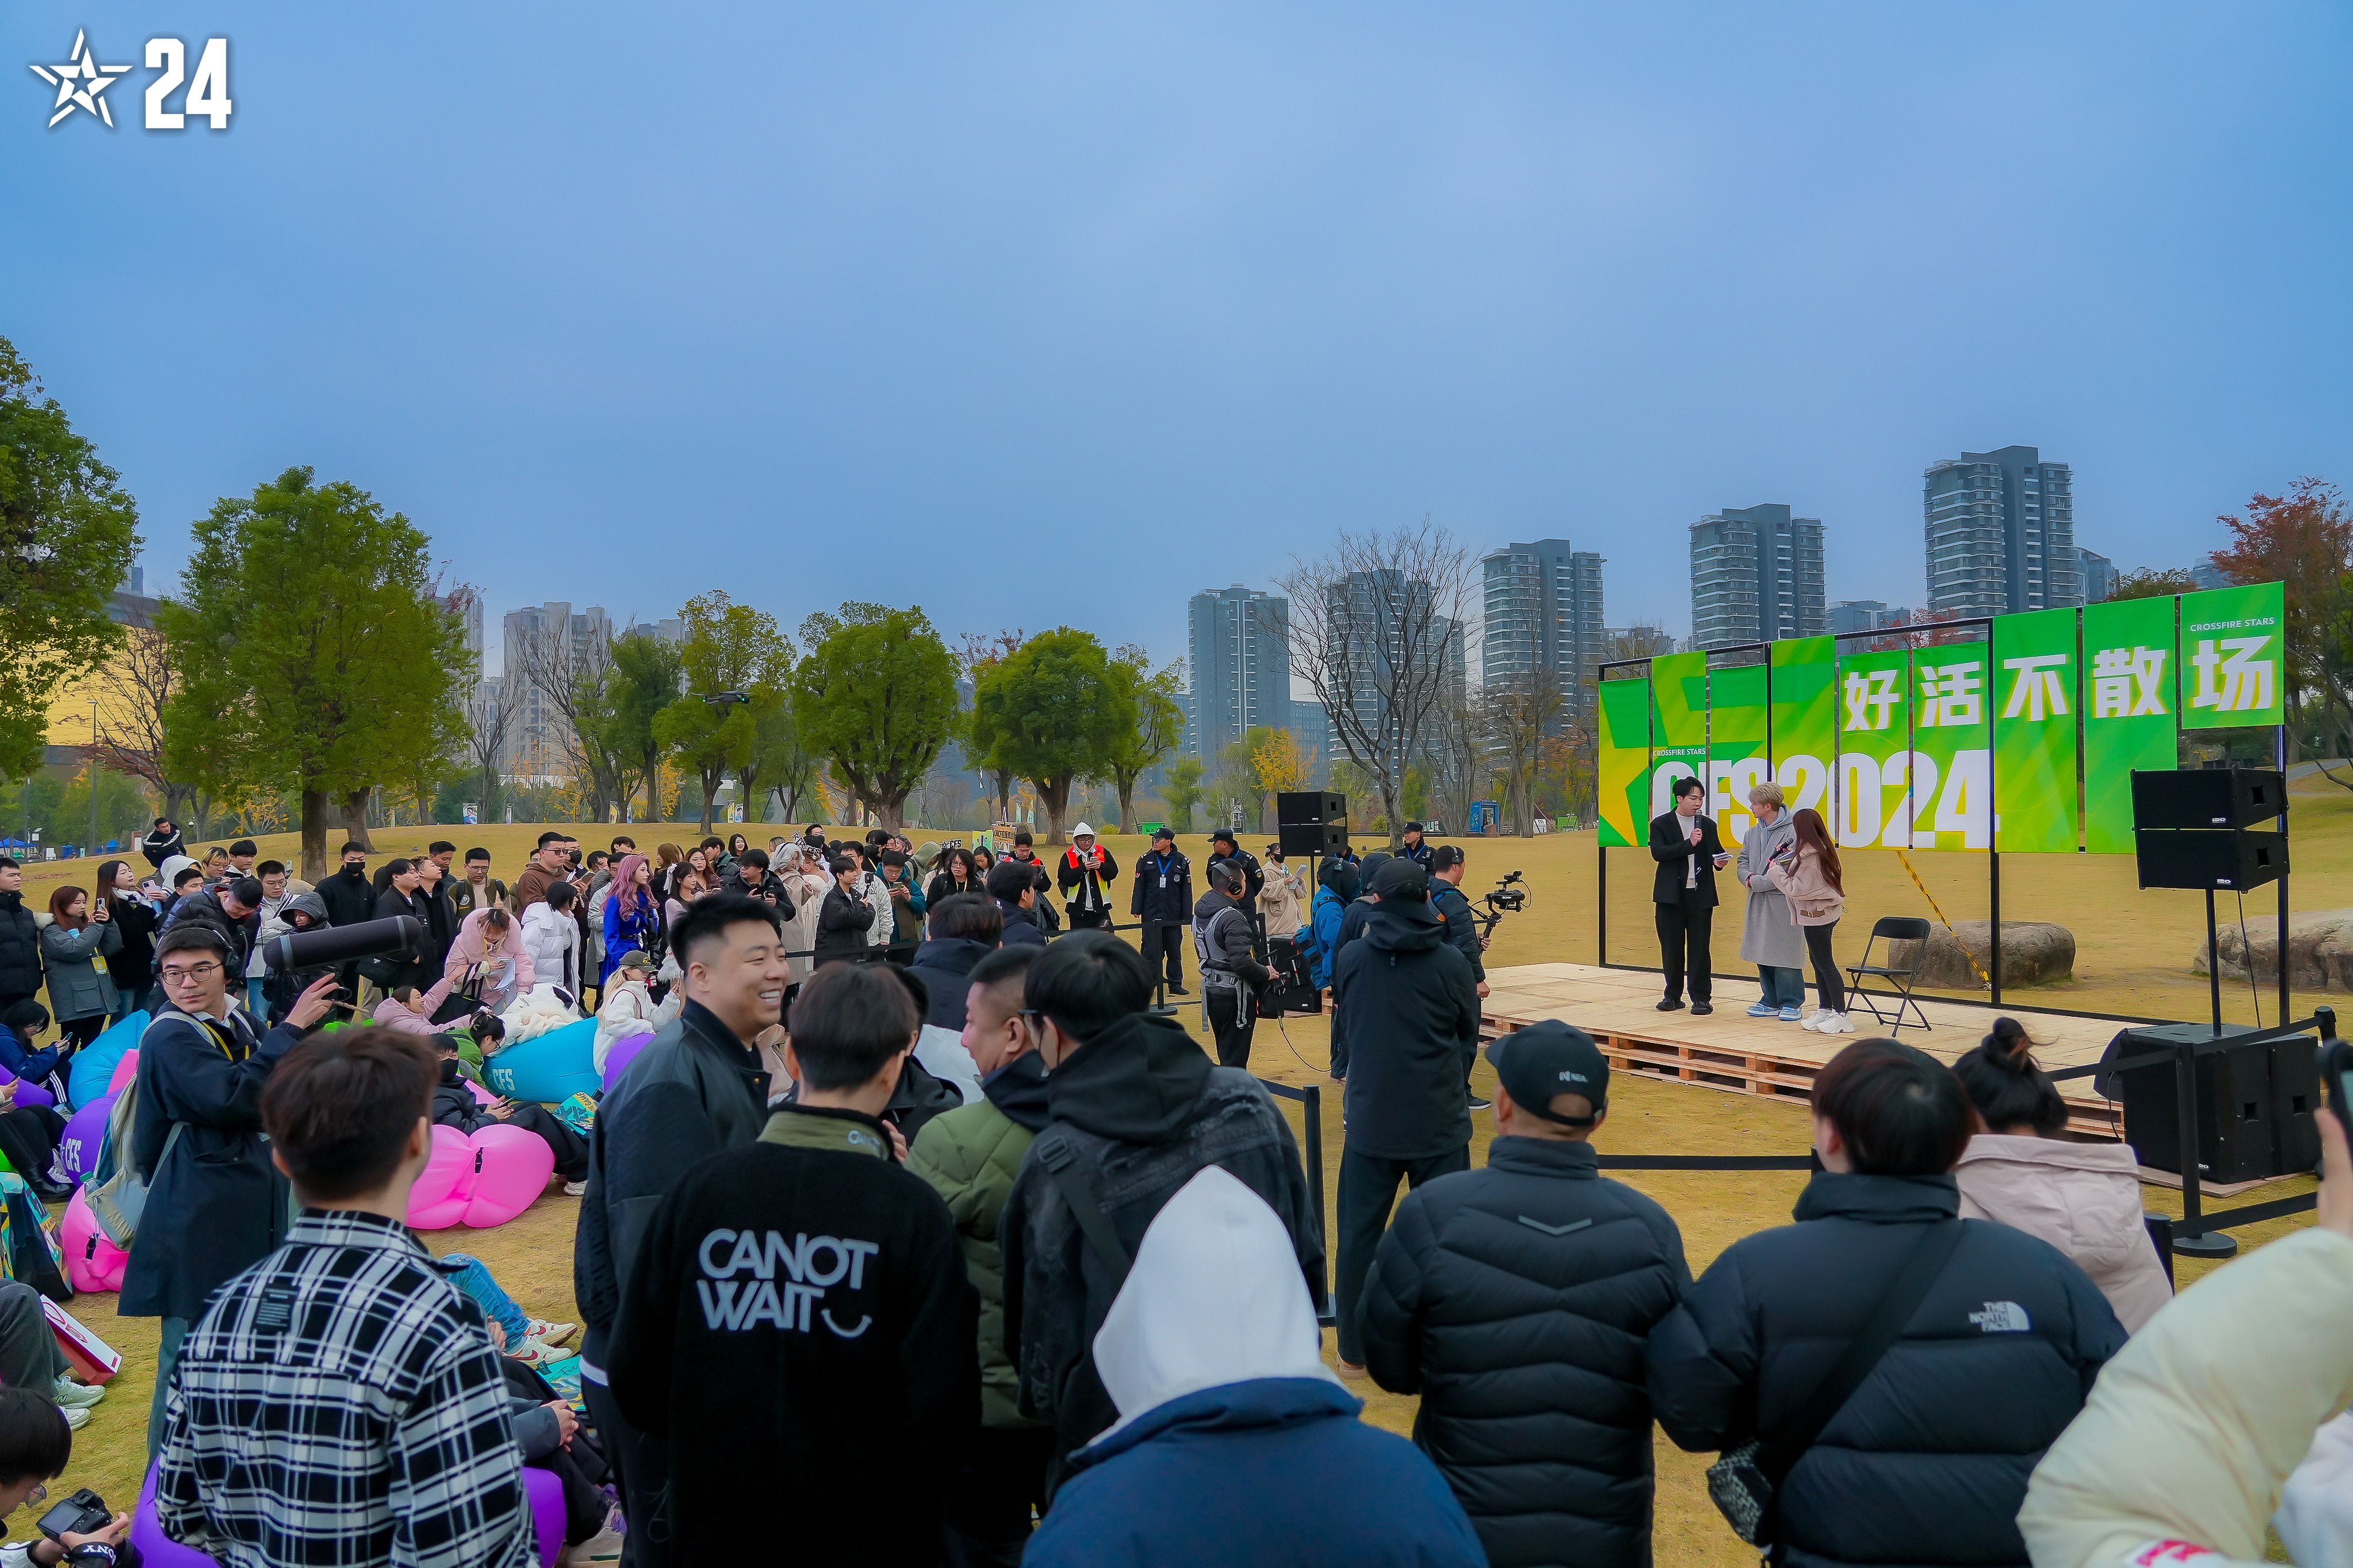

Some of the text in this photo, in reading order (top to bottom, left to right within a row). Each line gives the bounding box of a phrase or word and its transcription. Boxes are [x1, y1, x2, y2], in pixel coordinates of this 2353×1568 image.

[2189, 618, 2274, 632] CROSSFIRE STARS
[1844, 635, 2274, 731] 好活不散场
[949, 839, 962, 848] CFS
[492, 1068, 515, 1091] CFS
[65, 1137, 82, 1172] CFS
[699, 1228, 879, 1289] CANOT
[696, 1279, 825, 1332] WAIT
[1968, 1312, 2008, 1323] NORTH
